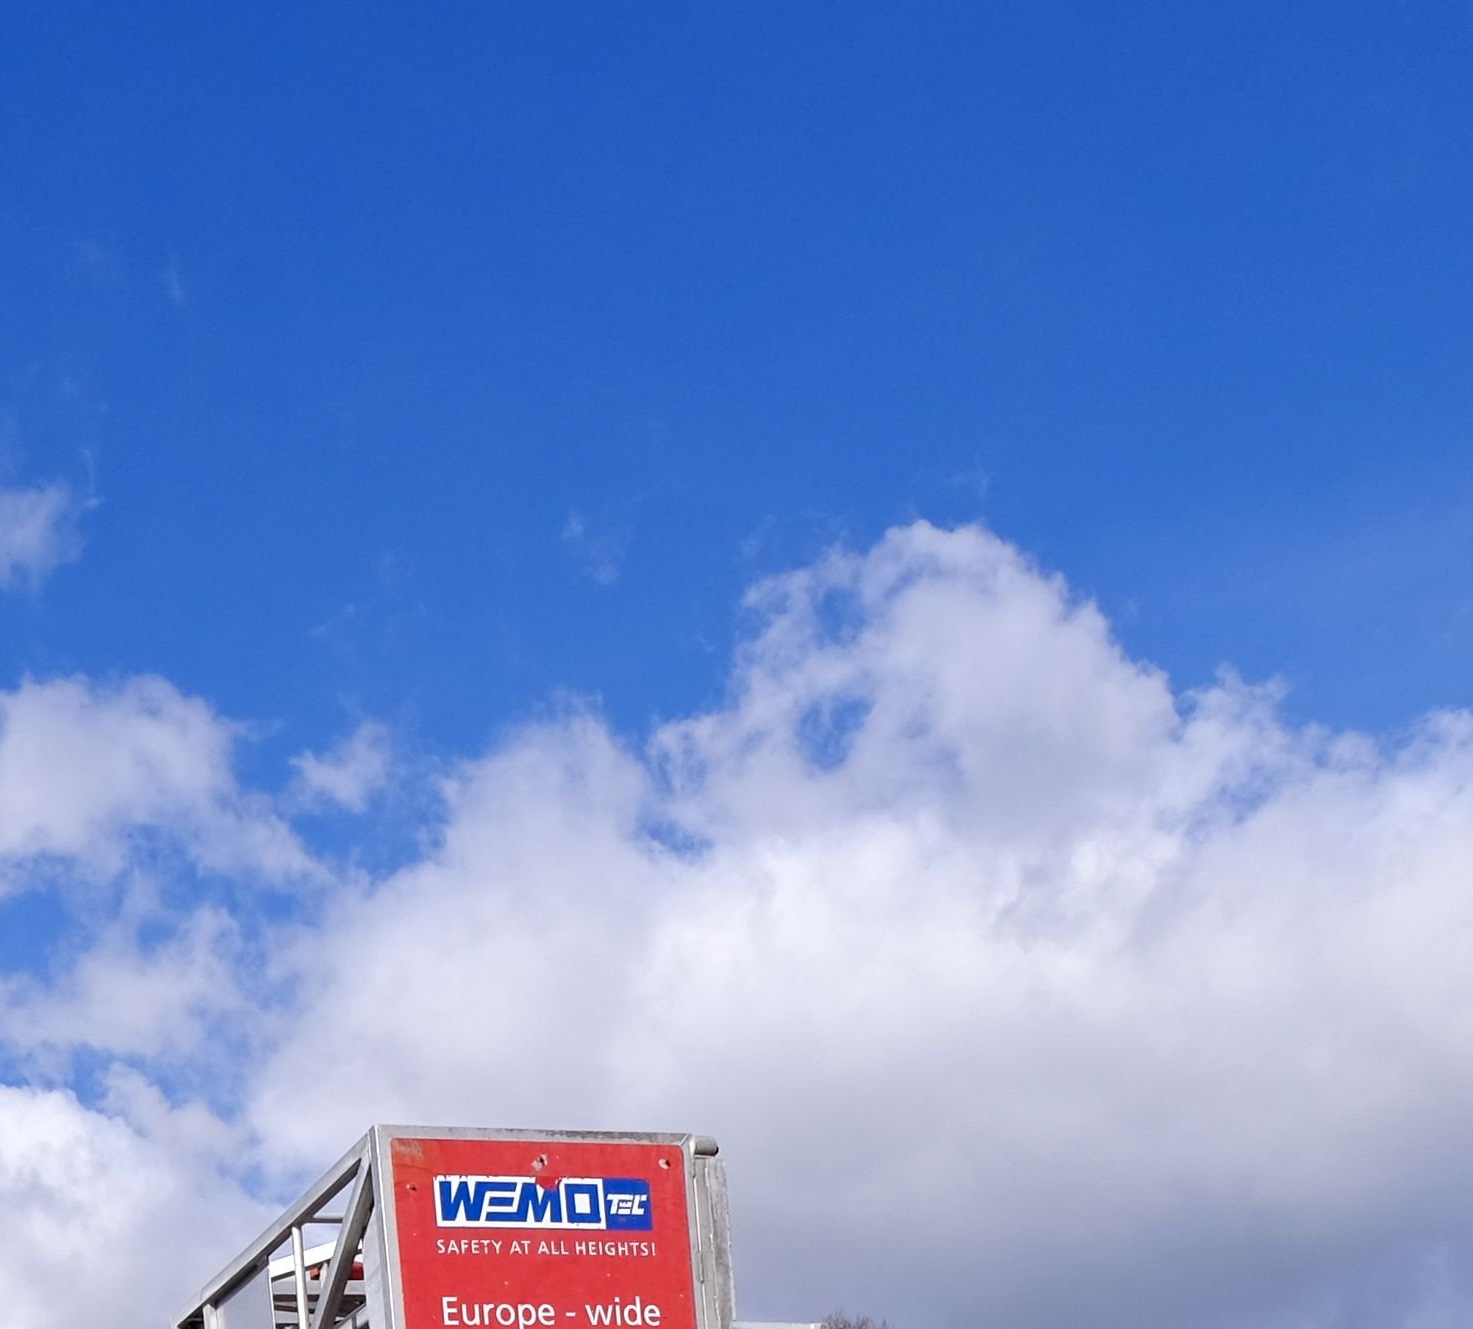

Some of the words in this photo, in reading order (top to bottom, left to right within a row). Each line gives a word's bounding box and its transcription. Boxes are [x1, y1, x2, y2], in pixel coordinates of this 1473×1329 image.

[439, 1180, 602, 1224] WEMO
[606, 1194, 647, 1215] TEC
[436, 1239, 502, 1255] SAFETY
[509, 1240, 531, 1255] AT
[538, 1240, 569, 1255] ALL
[575, 1241, 656, 1257] HEIGHTS!
[584, 1296, 661, 1327] wide
